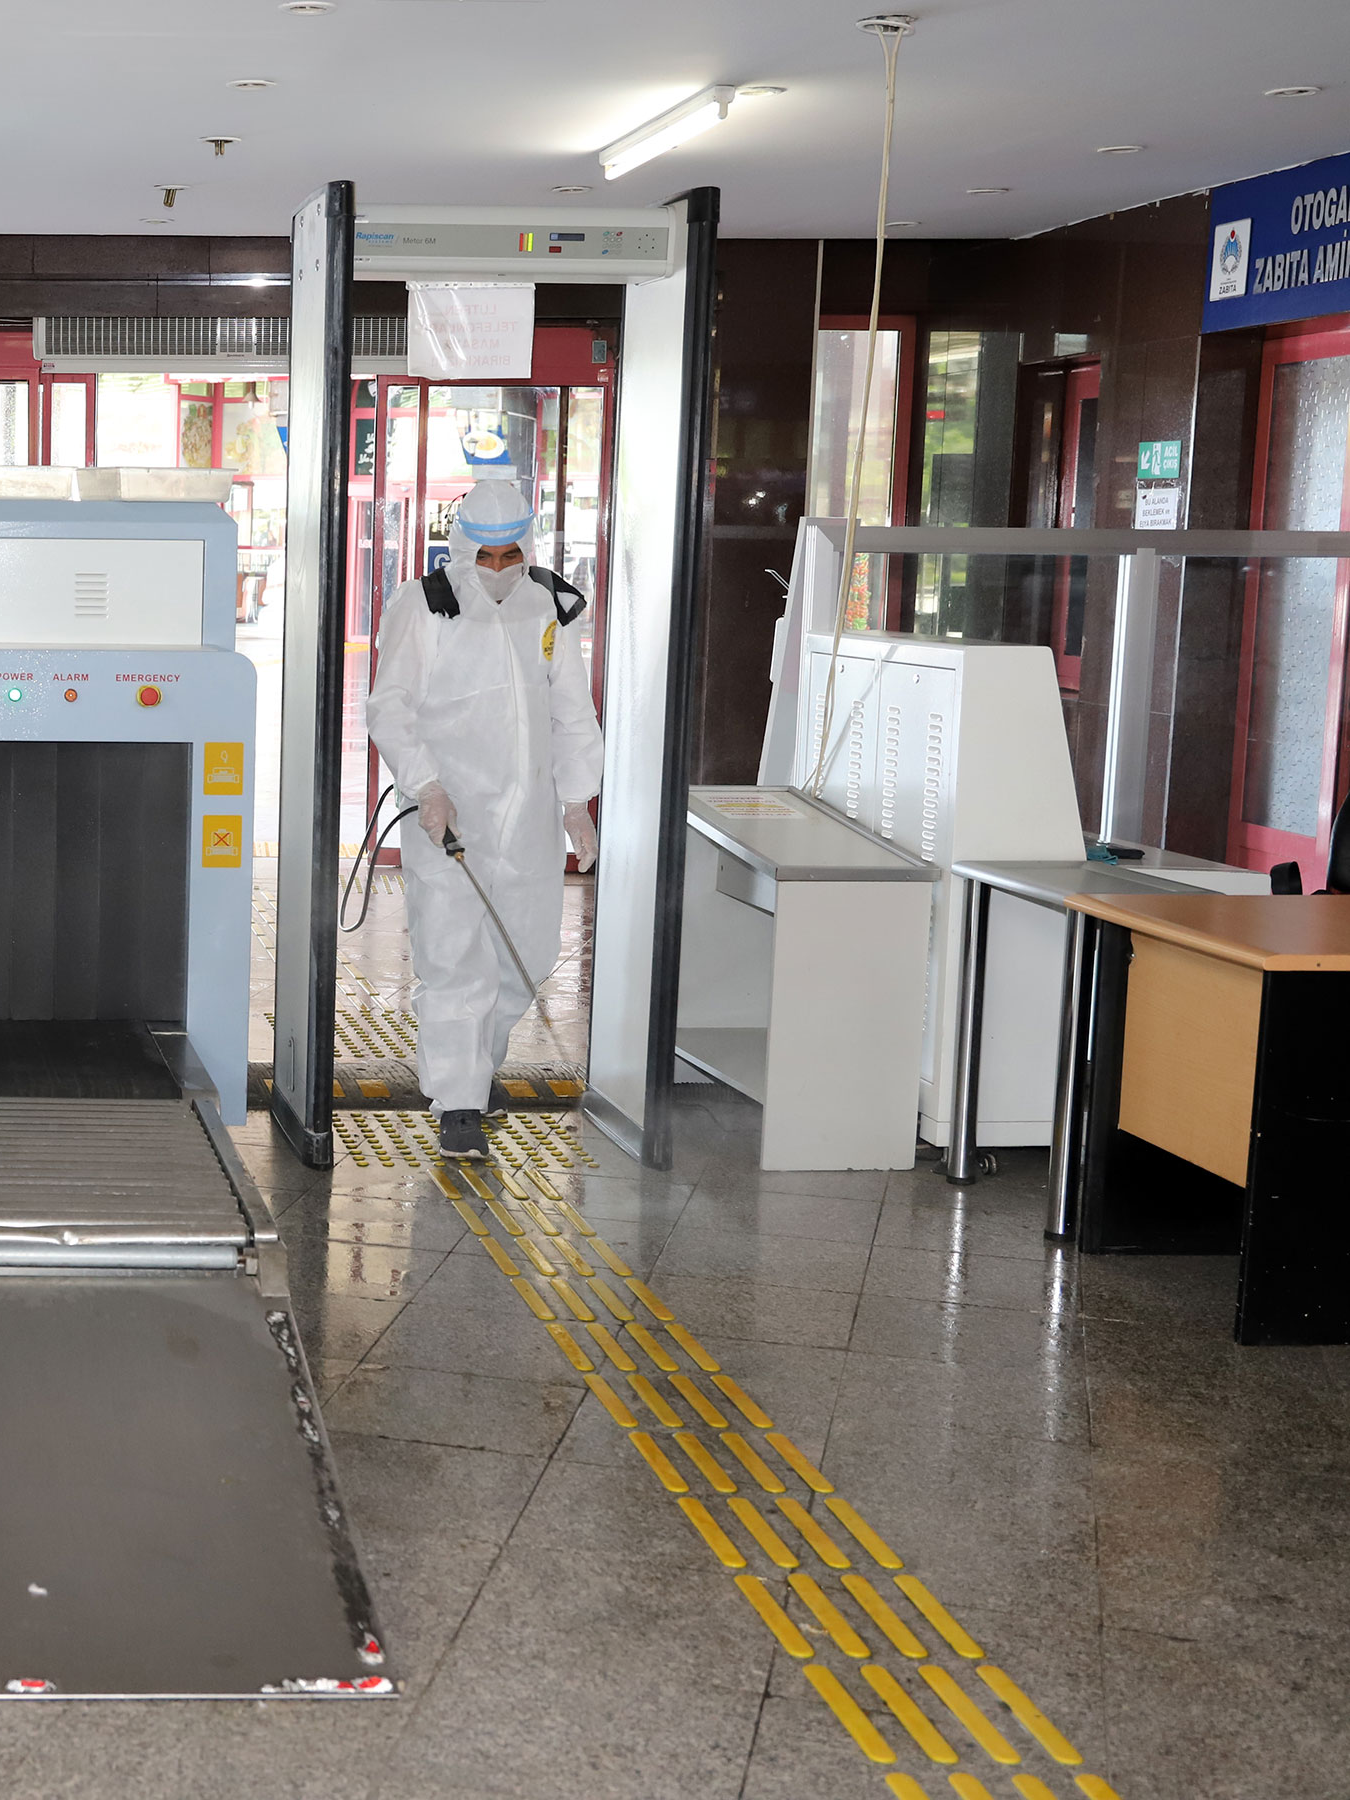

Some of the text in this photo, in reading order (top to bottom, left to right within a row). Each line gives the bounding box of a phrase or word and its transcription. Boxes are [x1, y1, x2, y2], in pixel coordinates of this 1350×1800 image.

[1291, 185, 1350, 235] OTOGA
[356, 232, 394, 241] Rapiscan
[1253, 249, 1309, 294] ZABITA
[1219, 284, 1237, 295] ZABITA
[53, 673, 89, 682] ALARM
[115, 673, 181, 683] EMERGENCY
